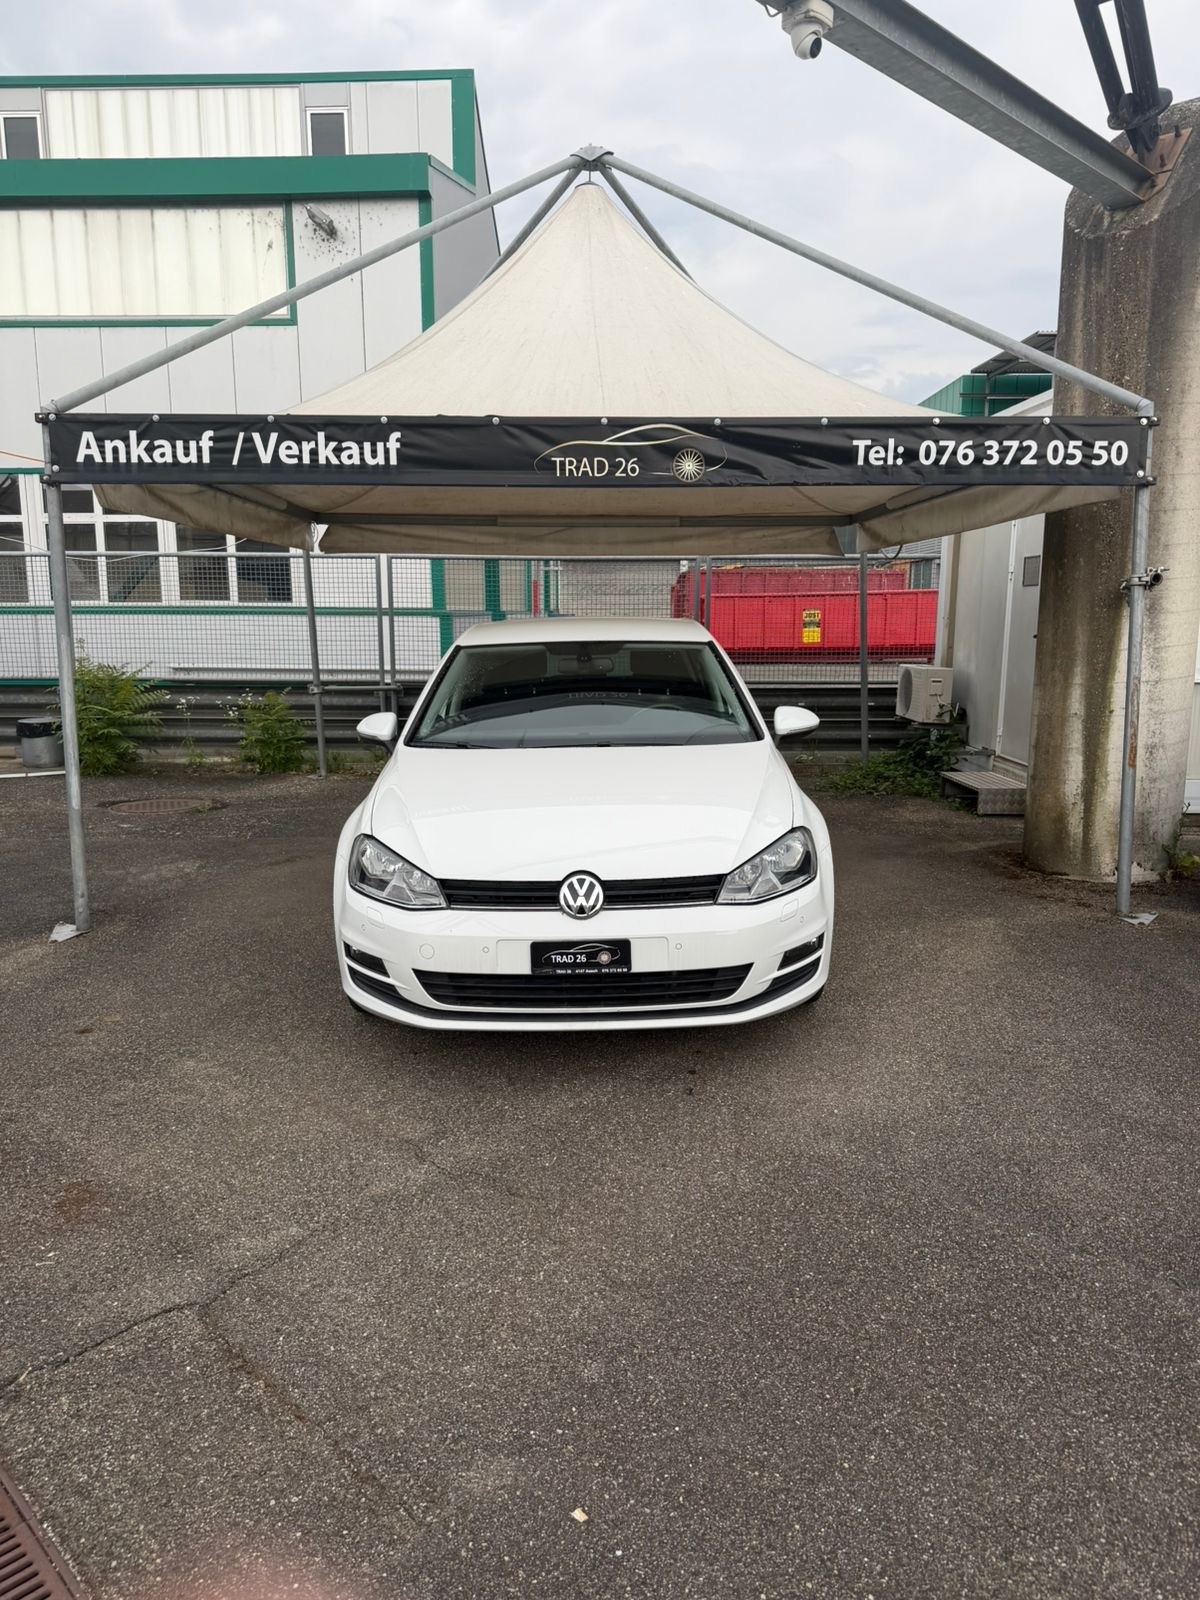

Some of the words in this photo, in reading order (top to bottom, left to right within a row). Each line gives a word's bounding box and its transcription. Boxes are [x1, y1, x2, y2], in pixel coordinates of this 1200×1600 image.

[76, 430, 214, 464] Ankauf
[852, 438, 905, 466] Tel:
[918, 440, 975, 466] 076
[982, 440, 1038, 466] 372
[1046, 440, 1083, 466] 05
[1091, 440, 1129, 466] 50
[551, 457, 609, 477] TRAD
[615, 457, 640, 477] 26
[550, 954, 575, 963] TRAD
[575, 954, 587, 963] 26
